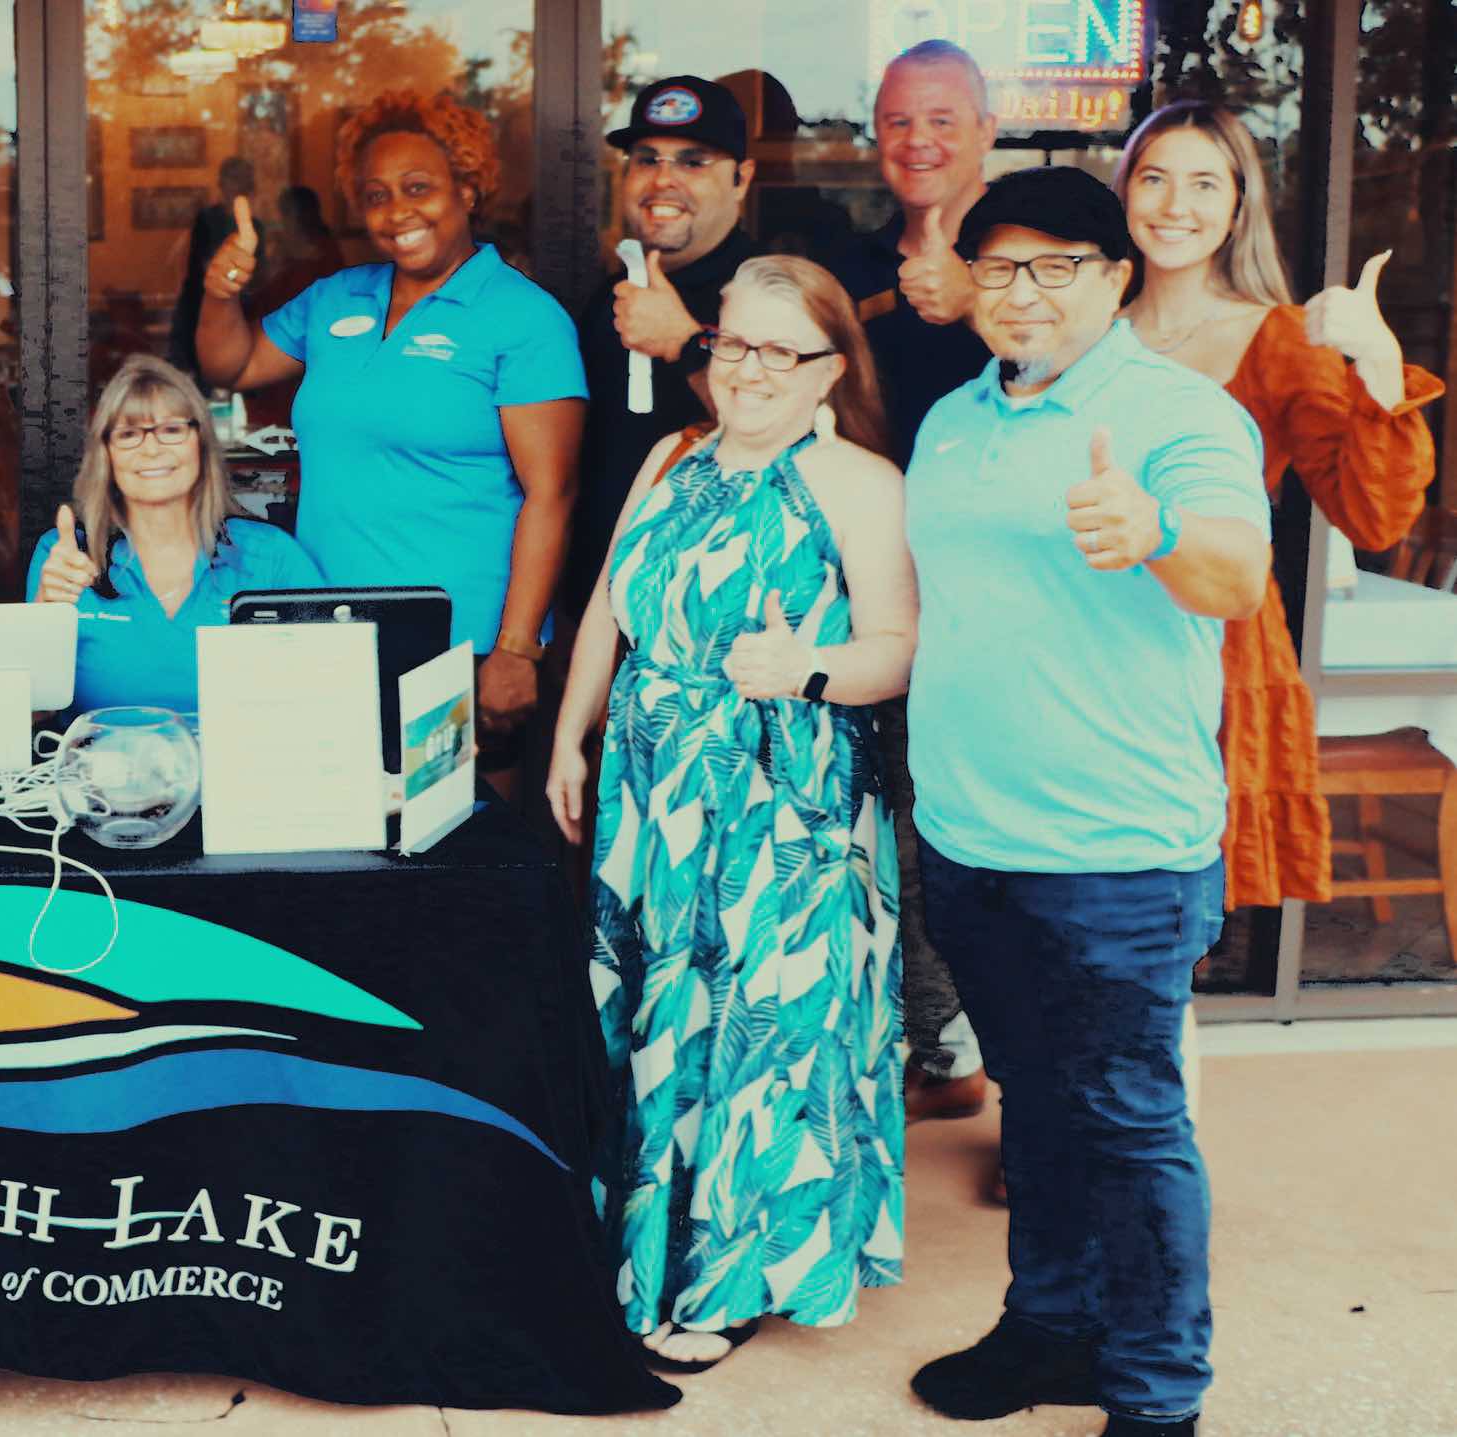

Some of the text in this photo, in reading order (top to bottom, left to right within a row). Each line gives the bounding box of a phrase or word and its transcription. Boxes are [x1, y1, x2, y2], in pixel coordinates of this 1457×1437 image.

[888, 0, 1132, 65] OPEN
[1000, 87, 1124, 126] Daily!
[103, 1175, 362, 1273] LAKE
[1, 1267, 40, 1301] of
[42, 1265, 284, 1311] COMMERCE
